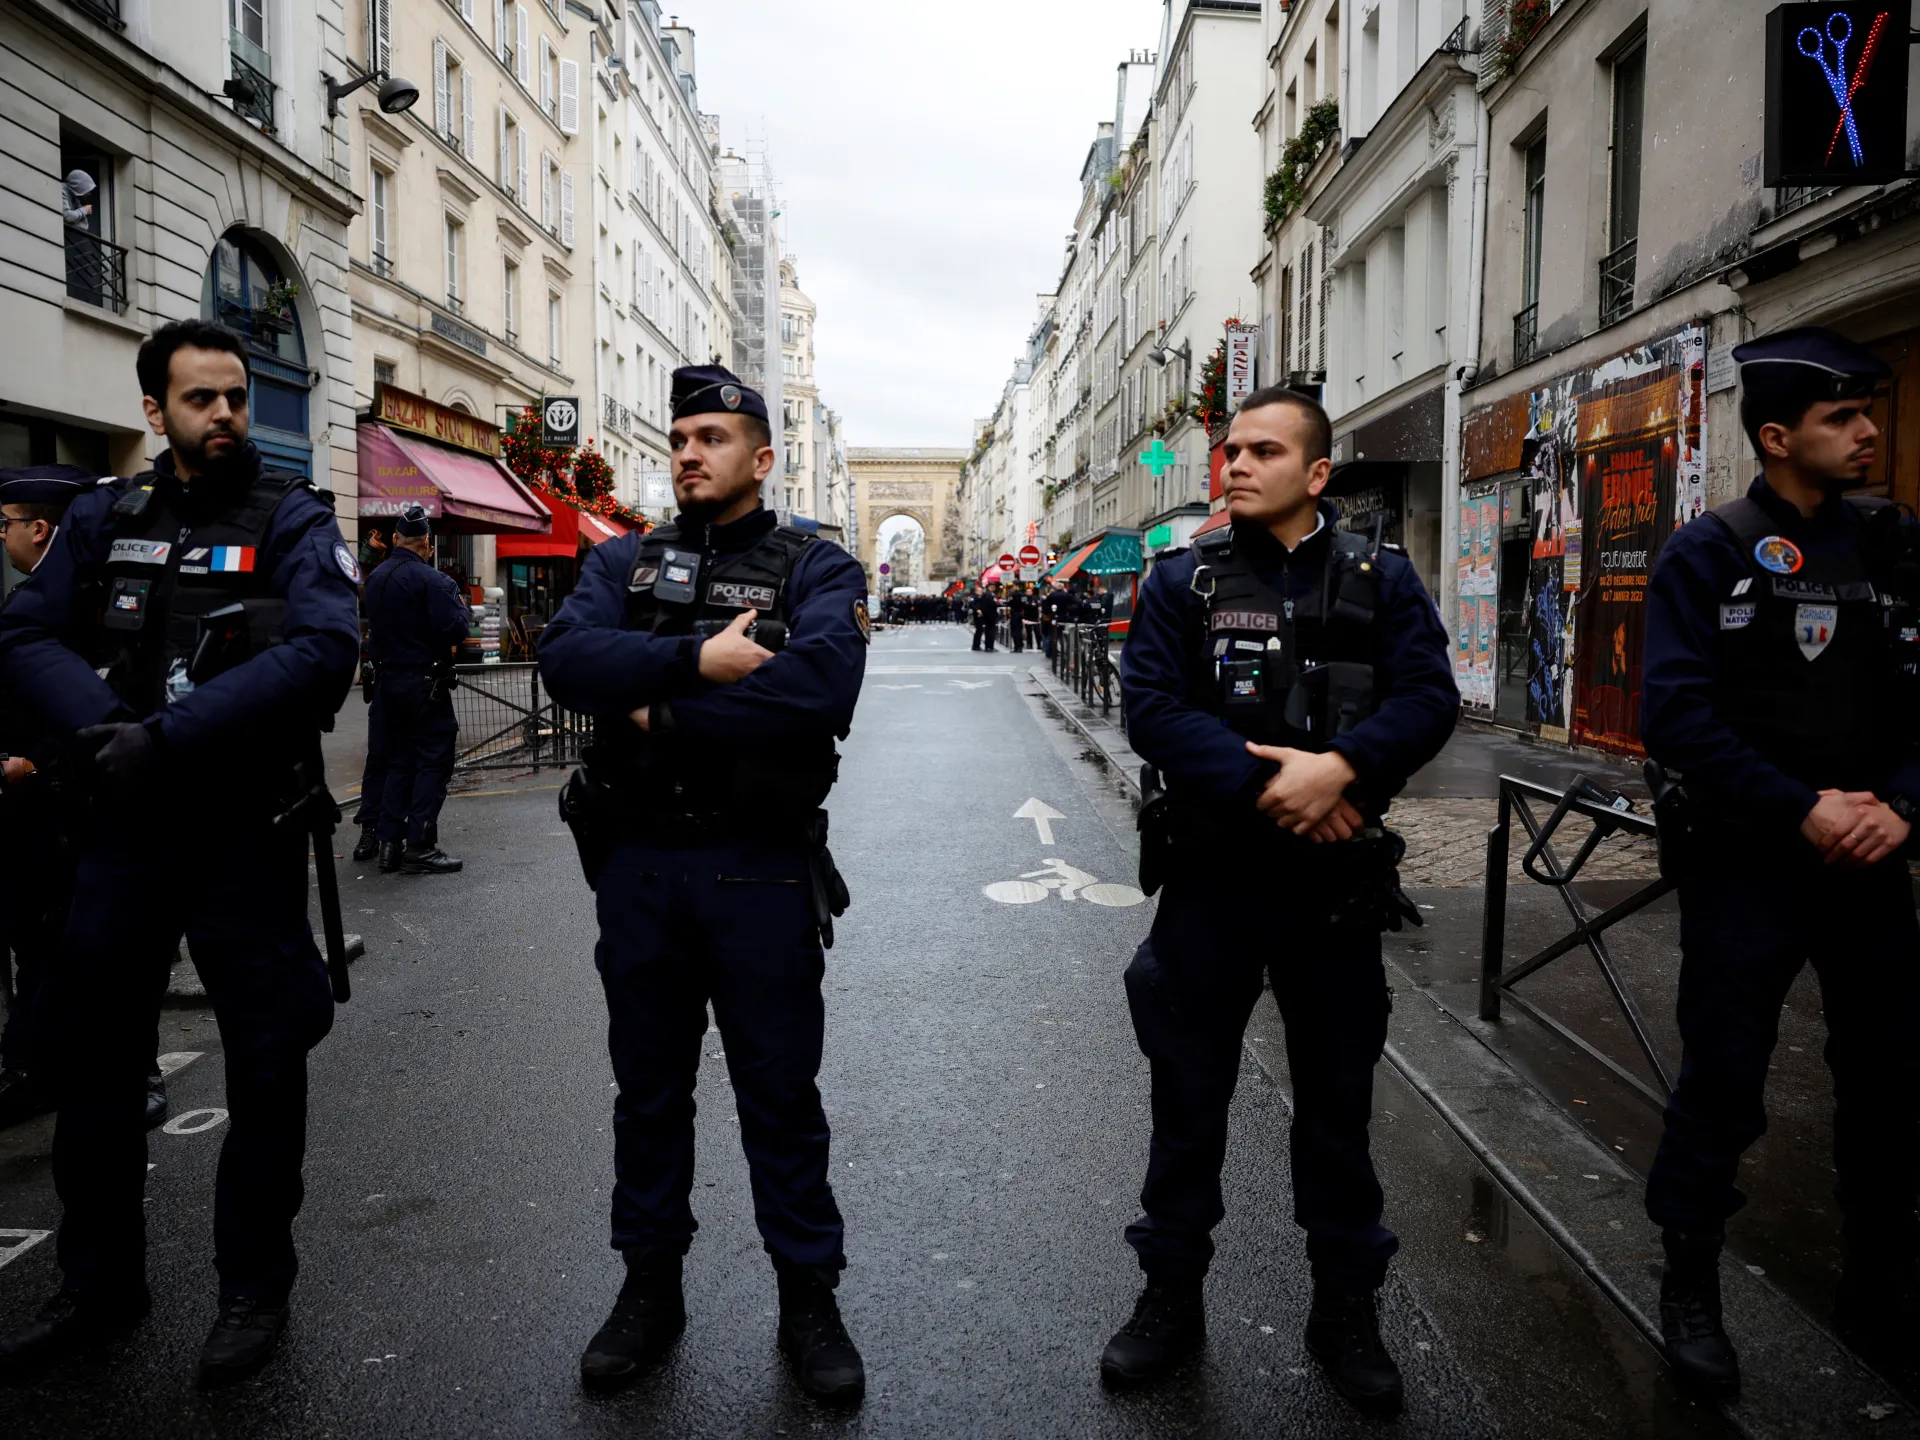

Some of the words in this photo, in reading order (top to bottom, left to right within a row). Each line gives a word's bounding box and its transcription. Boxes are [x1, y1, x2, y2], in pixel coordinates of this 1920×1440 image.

[1233, 337, 1248, 397] JEANNETTE
[385, 394, 427, 429] BAZAR
[435, 409, 465, 443] STOC
[471, 423, 492, 452] PRIX
[1610, 449, 1645, 470] FABRICE
[378, 467, 418, 477] BAZAR
[378, 485, 438, 497] COULEURS
[112, 543, 150, 553] OLICE
[713, 584, 772, 601] POLICE
[1776, 578, 1833, 595] POLICE
[1213, 612, 1276, 629] POLICE
[1729, 608, 1756, 616] POLI
[1235, 680, 1254, 688] POLICE
